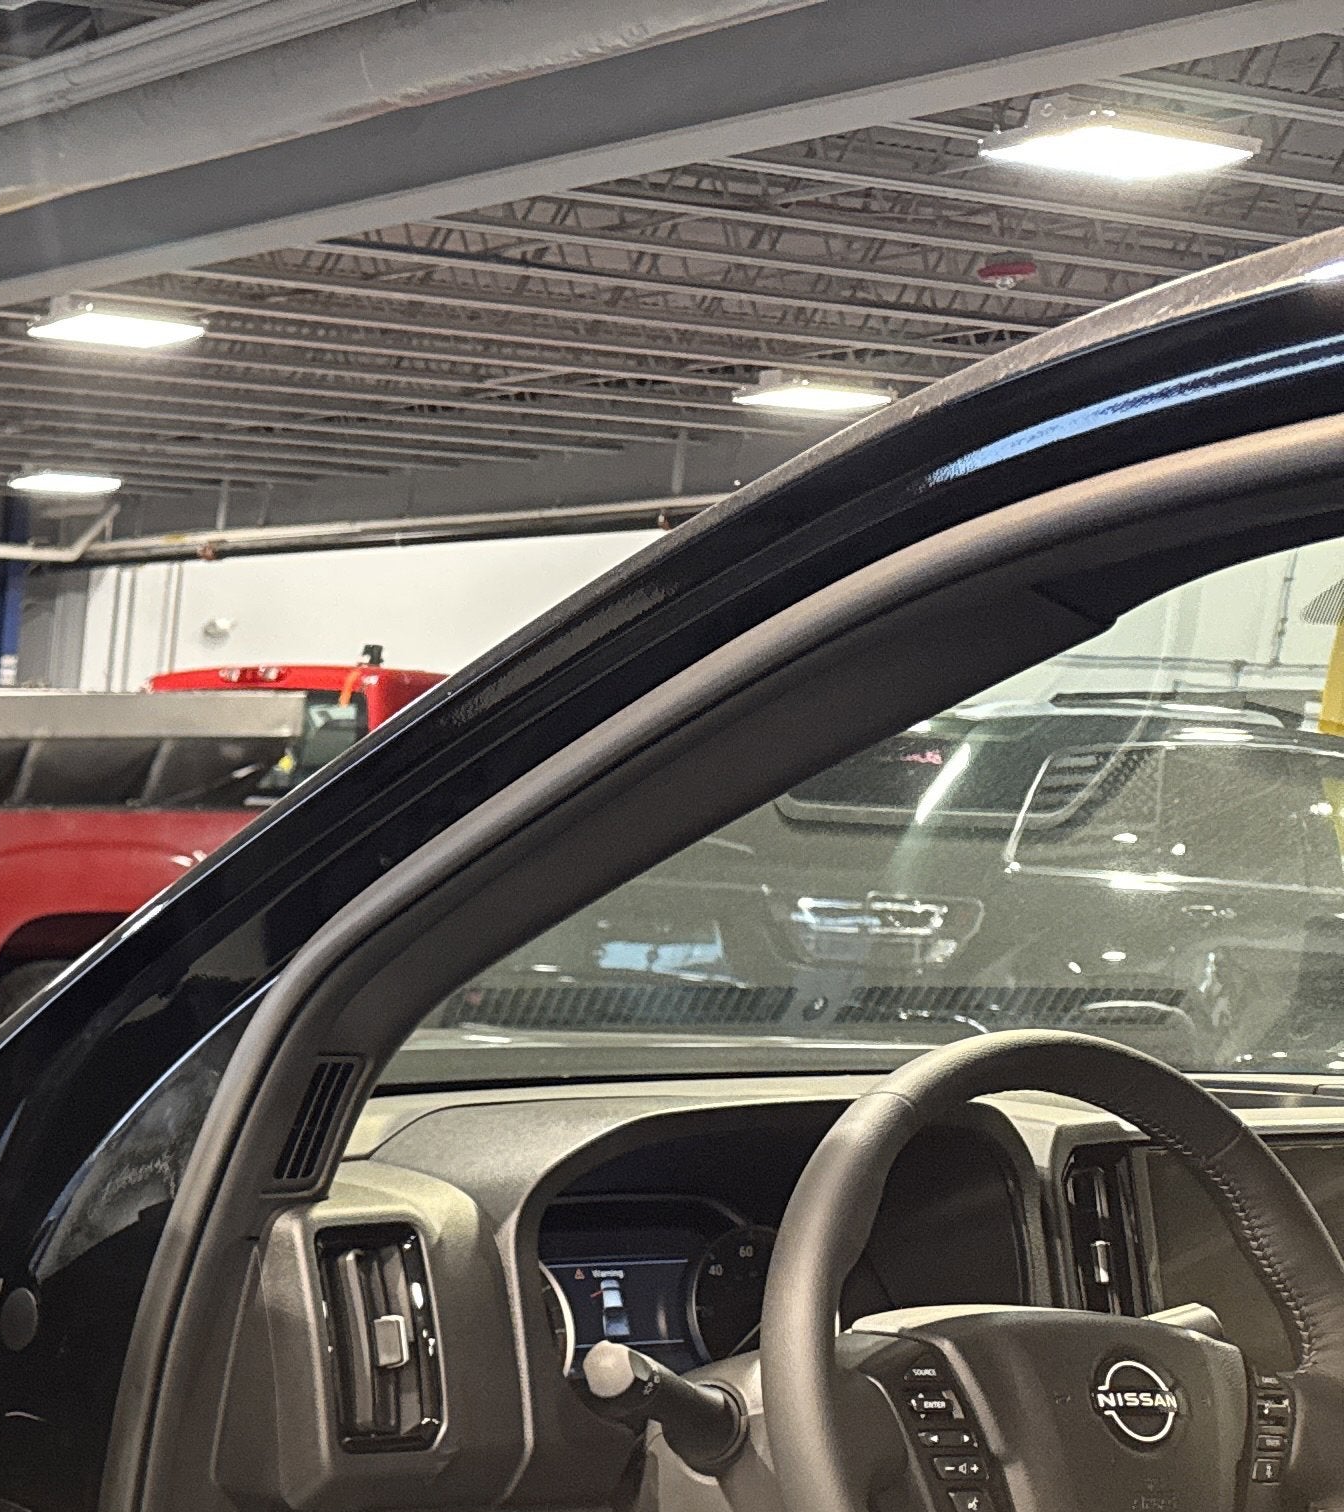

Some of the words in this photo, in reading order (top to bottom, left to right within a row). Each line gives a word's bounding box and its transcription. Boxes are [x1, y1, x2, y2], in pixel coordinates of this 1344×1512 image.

[739, 1245, 753, 1258] 60
[708, 1264, 723, 1276] 40
[923, 1400, 946, 1409] ENTER
[1096, 1391, 1178, 1409] NISSAN
